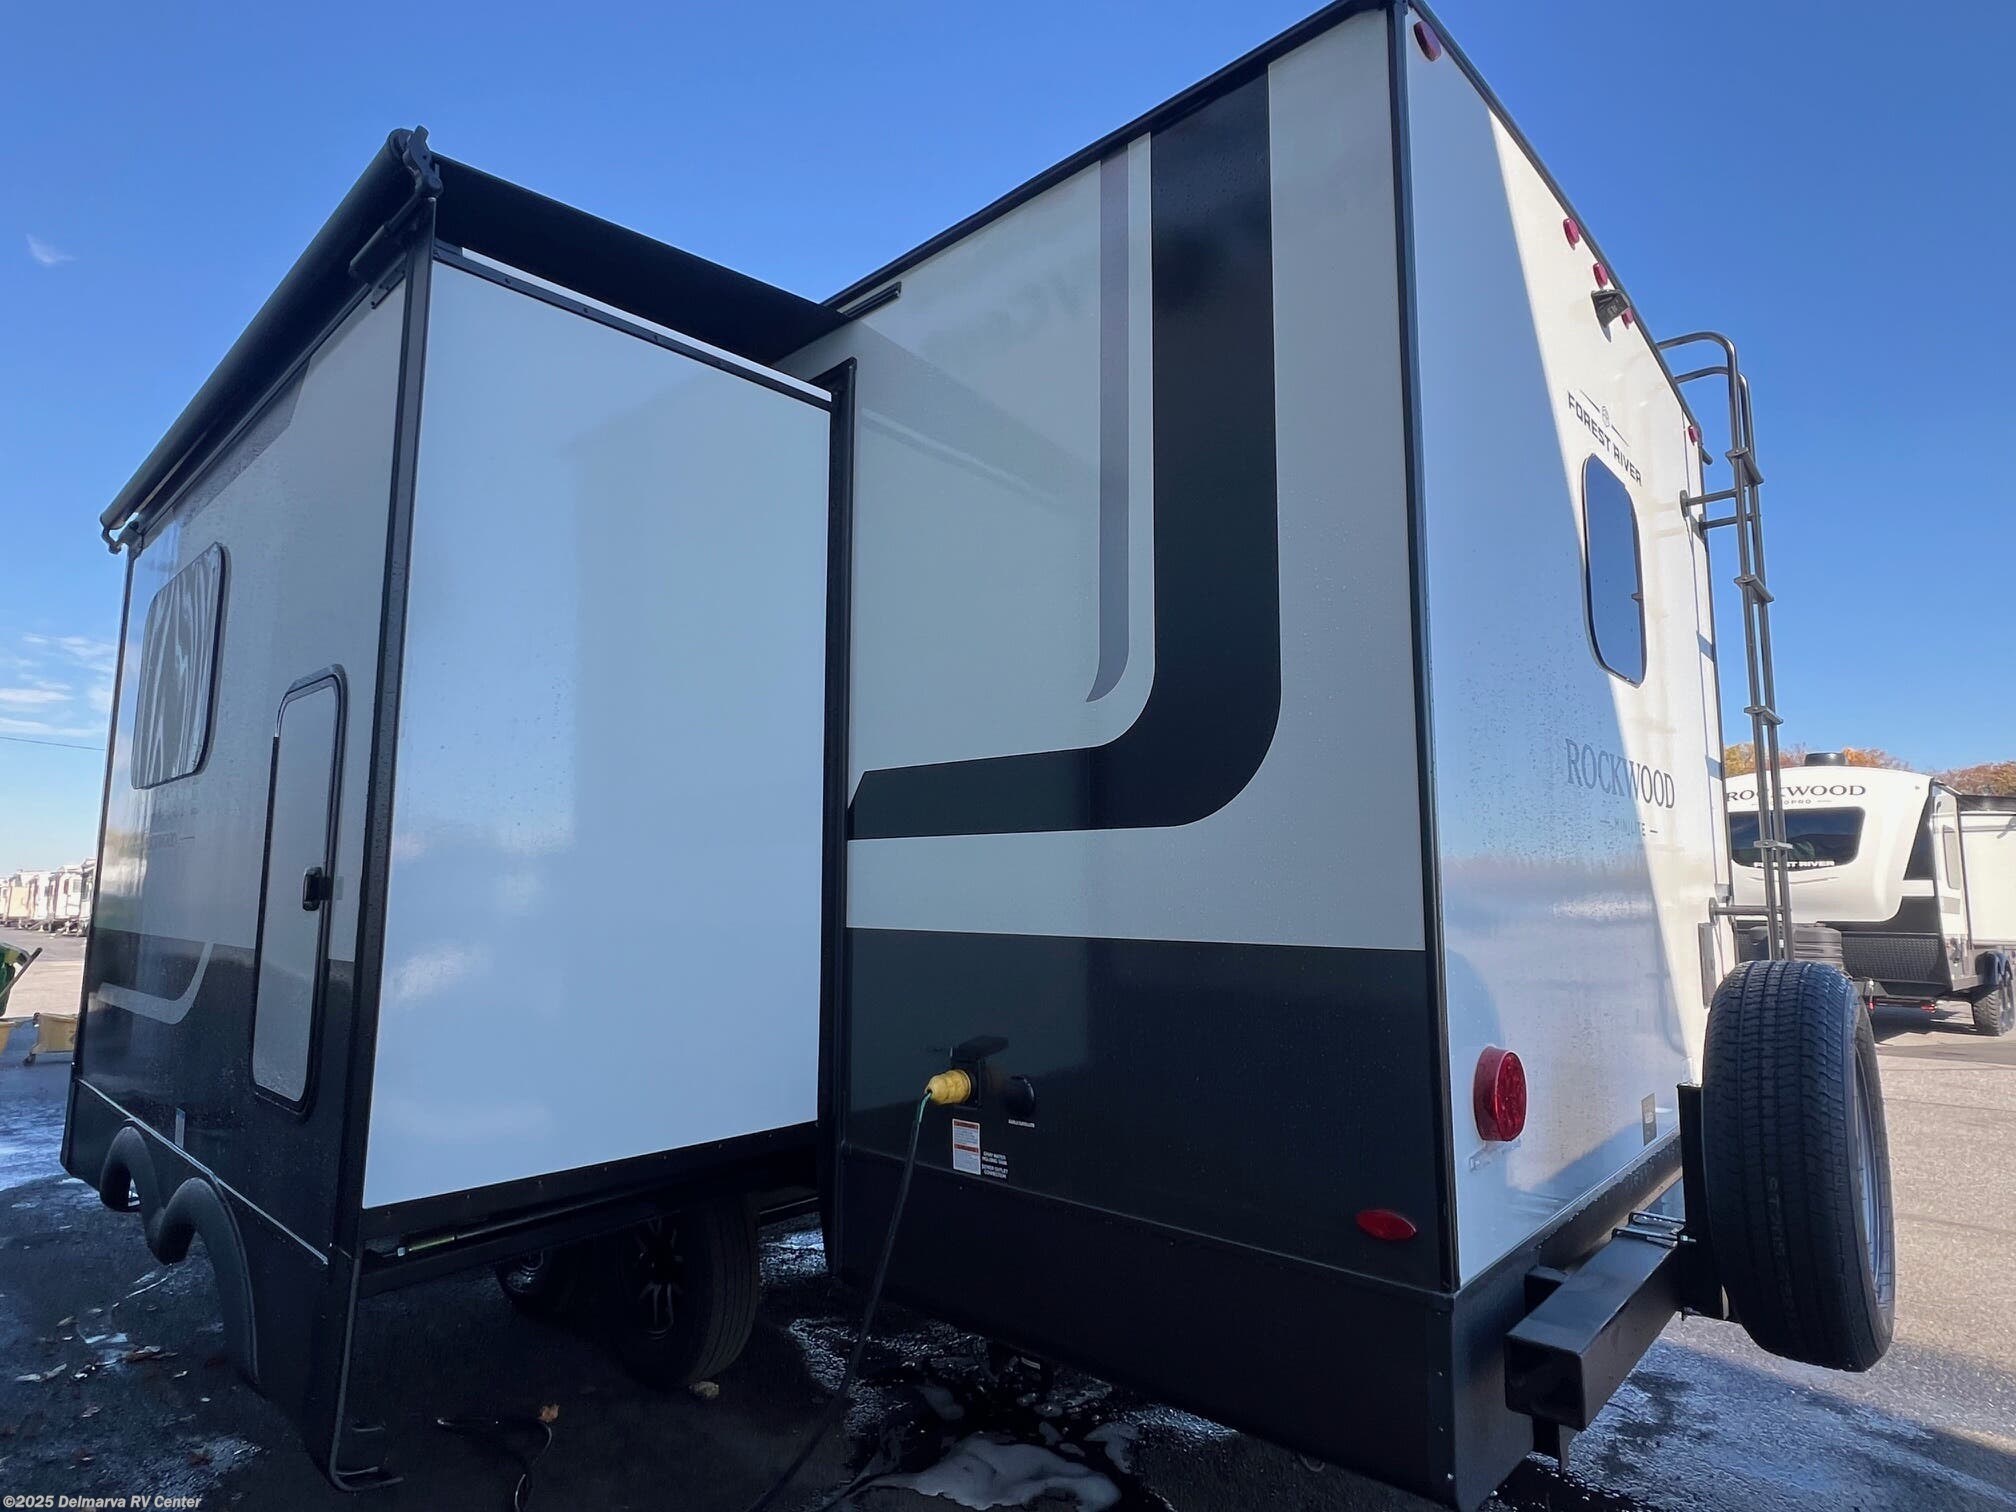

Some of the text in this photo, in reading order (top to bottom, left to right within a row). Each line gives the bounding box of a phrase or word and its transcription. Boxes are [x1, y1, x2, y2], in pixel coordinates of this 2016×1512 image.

[1567, 390, 1642, 487] FOREST RIVER
[1565, 738, 1675, 809] ROCKWOOD
[1727, 785, 1867, 802] ROWOOD
[1799, 860, 1835, 868] RIVER
